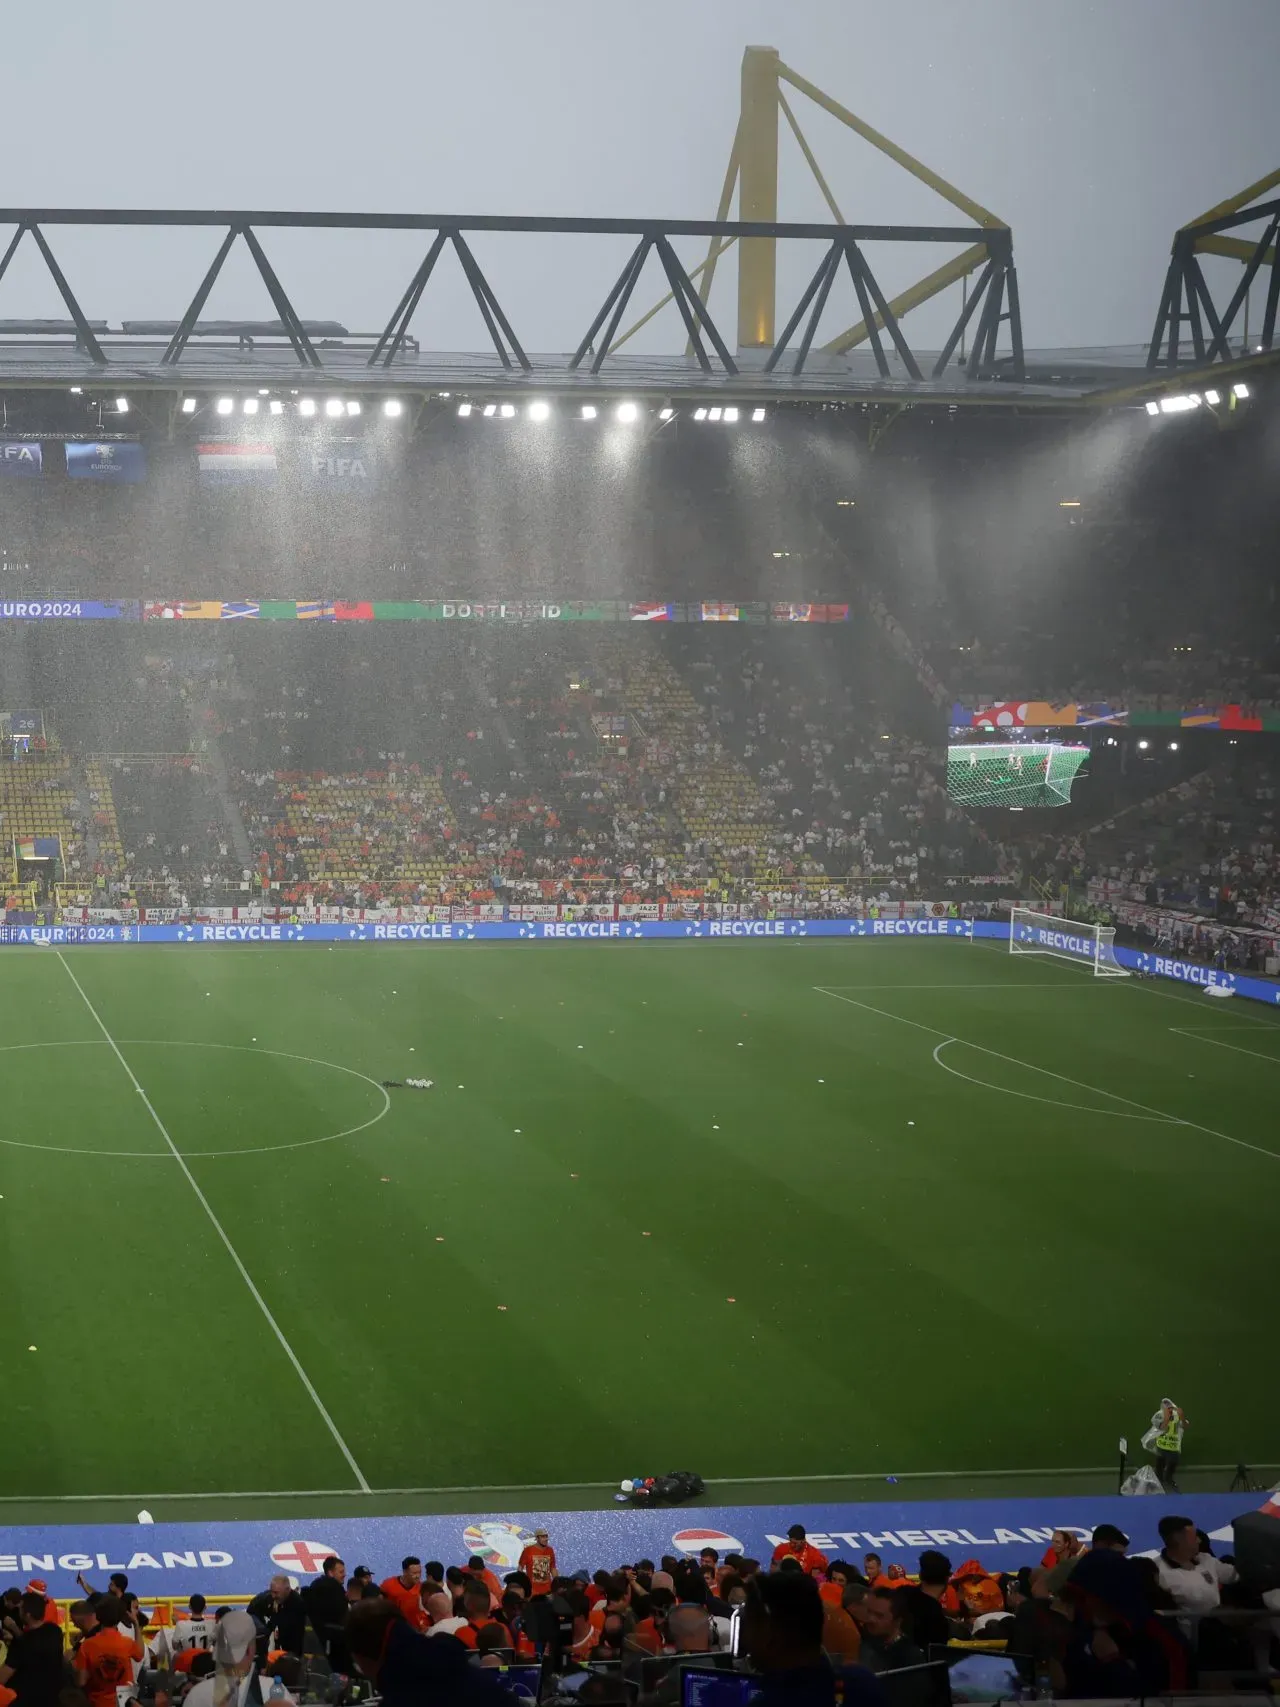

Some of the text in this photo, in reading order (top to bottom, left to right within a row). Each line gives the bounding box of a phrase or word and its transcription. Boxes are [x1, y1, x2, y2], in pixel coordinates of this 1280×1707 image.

[311, 457, 367, 477] FIFA
[202, 926, 281, 940] RECYCLE
[375, 925, 452, 938] RECYCLE
[542, 923, 620, 937] RECYCLE
[710, 922, 785, 935] RECYCLE
[873, 920, 948, 933] RECYCLE
[1039, 930, 1090, 954] RECYCLE
[1154, 963, 1217, 986] RECYCLE
[764, 1526, 1130, 1549] ETHERLAND
[188, 1635, 207, 1649] 11
